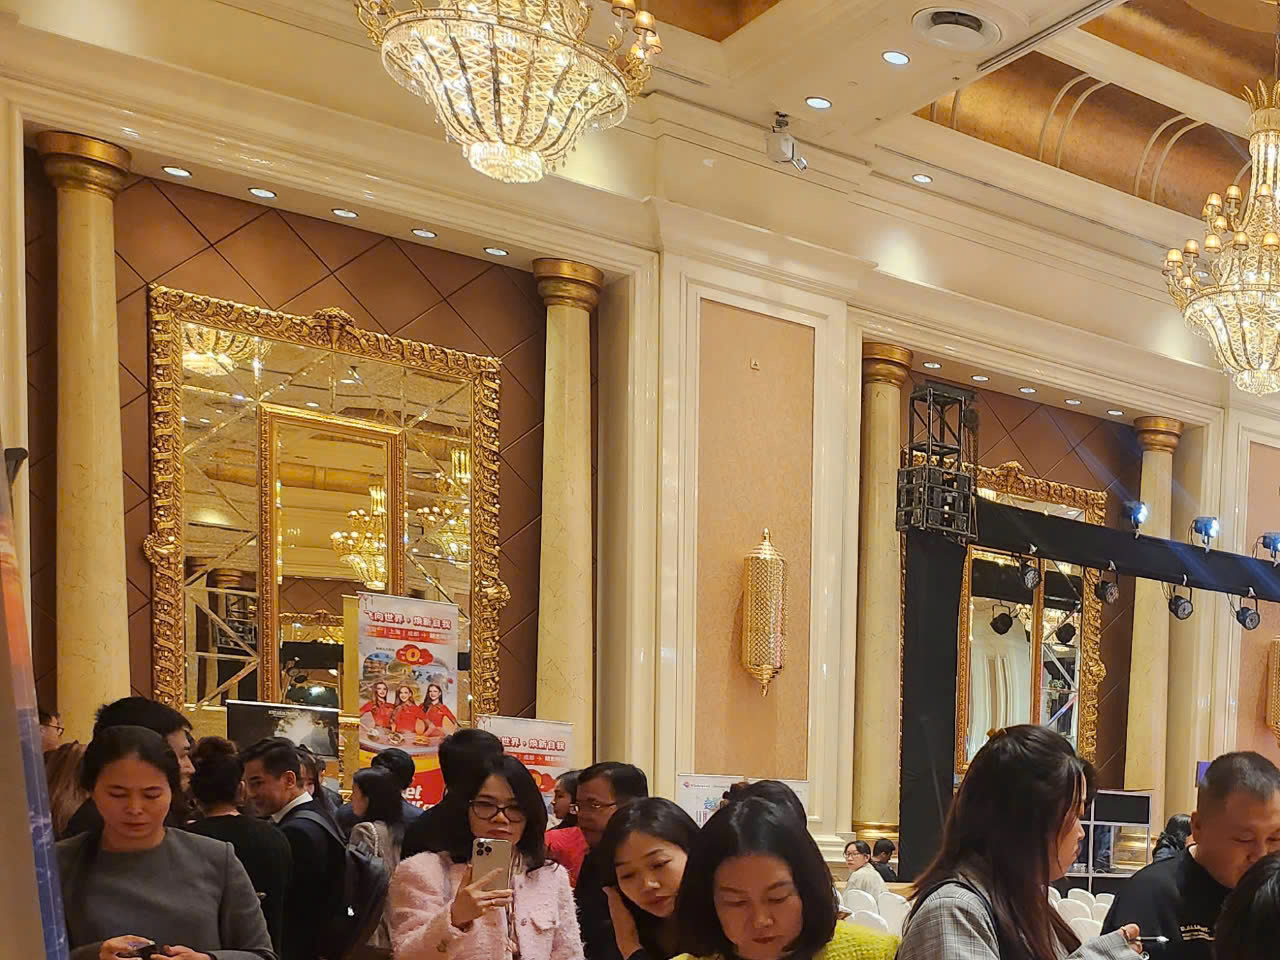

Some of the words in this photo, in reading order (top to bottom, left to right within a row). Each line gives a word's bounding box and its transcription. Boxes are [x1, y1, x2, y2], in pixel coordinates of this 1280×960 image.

[499, 735, 566, 752] 世界，焕新自我
